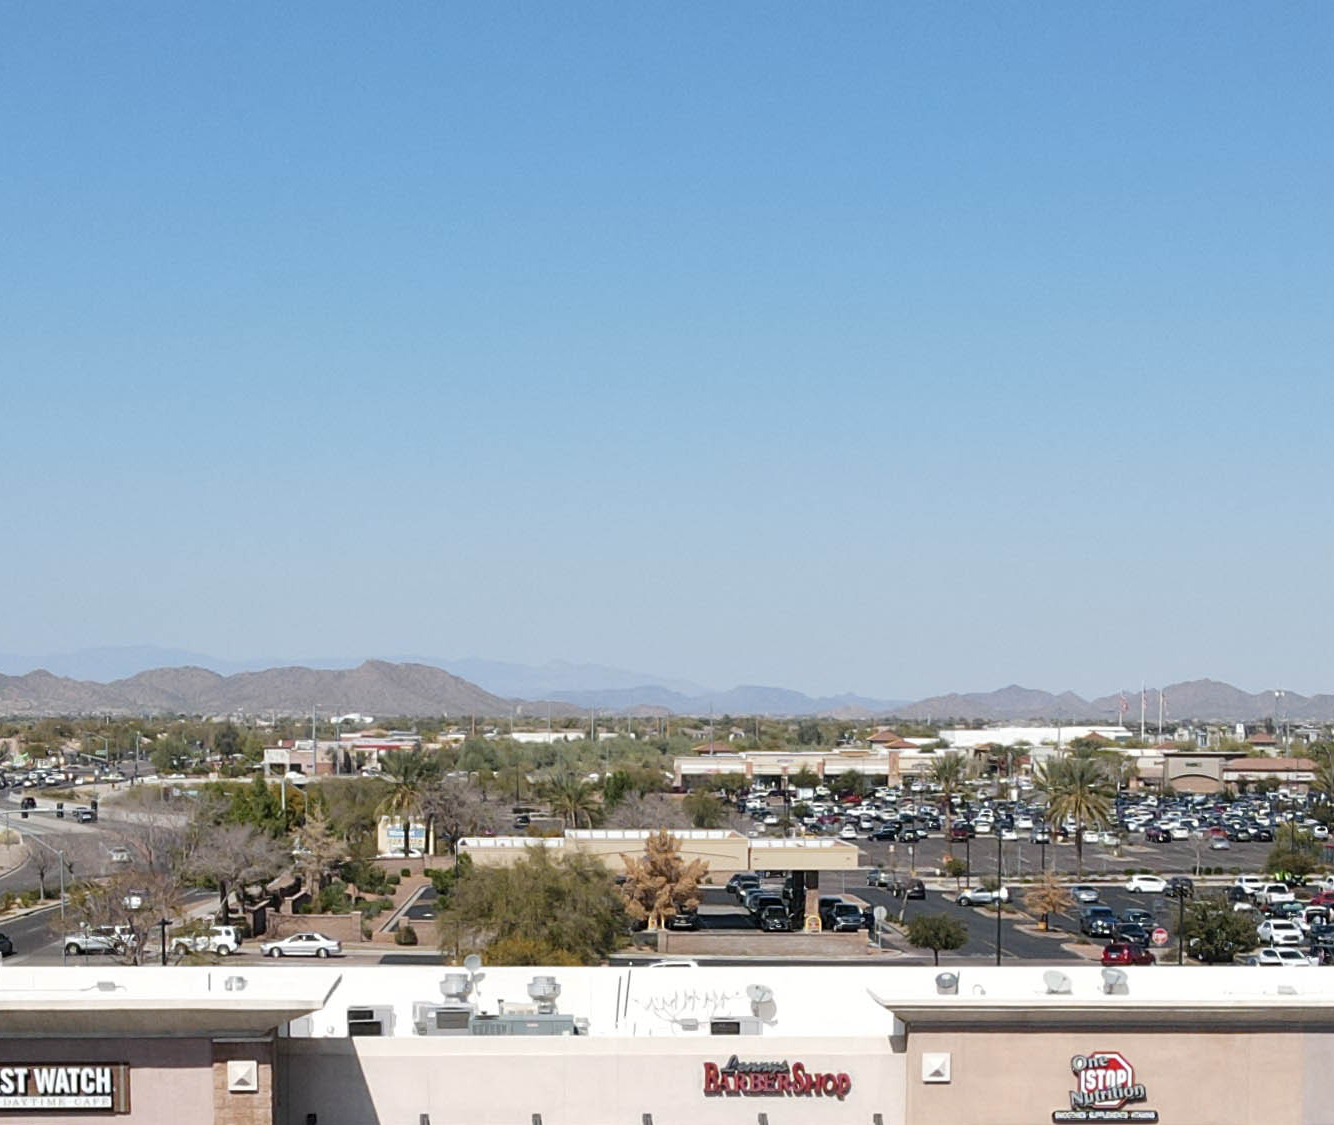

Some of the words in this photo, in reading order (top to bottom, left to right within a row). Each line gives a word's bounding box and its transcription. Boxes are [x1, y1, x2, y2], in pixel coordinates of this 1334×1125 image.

[1070, 1055, 1109, 1072] One
[33, 1067, 112, 1094] WATCH
[1085, 1069, 1128, 1090] STOP
[3, 1097, 68, 1107] DAYTIME
[1069, 1084, 1147, 1108] Nutrition
